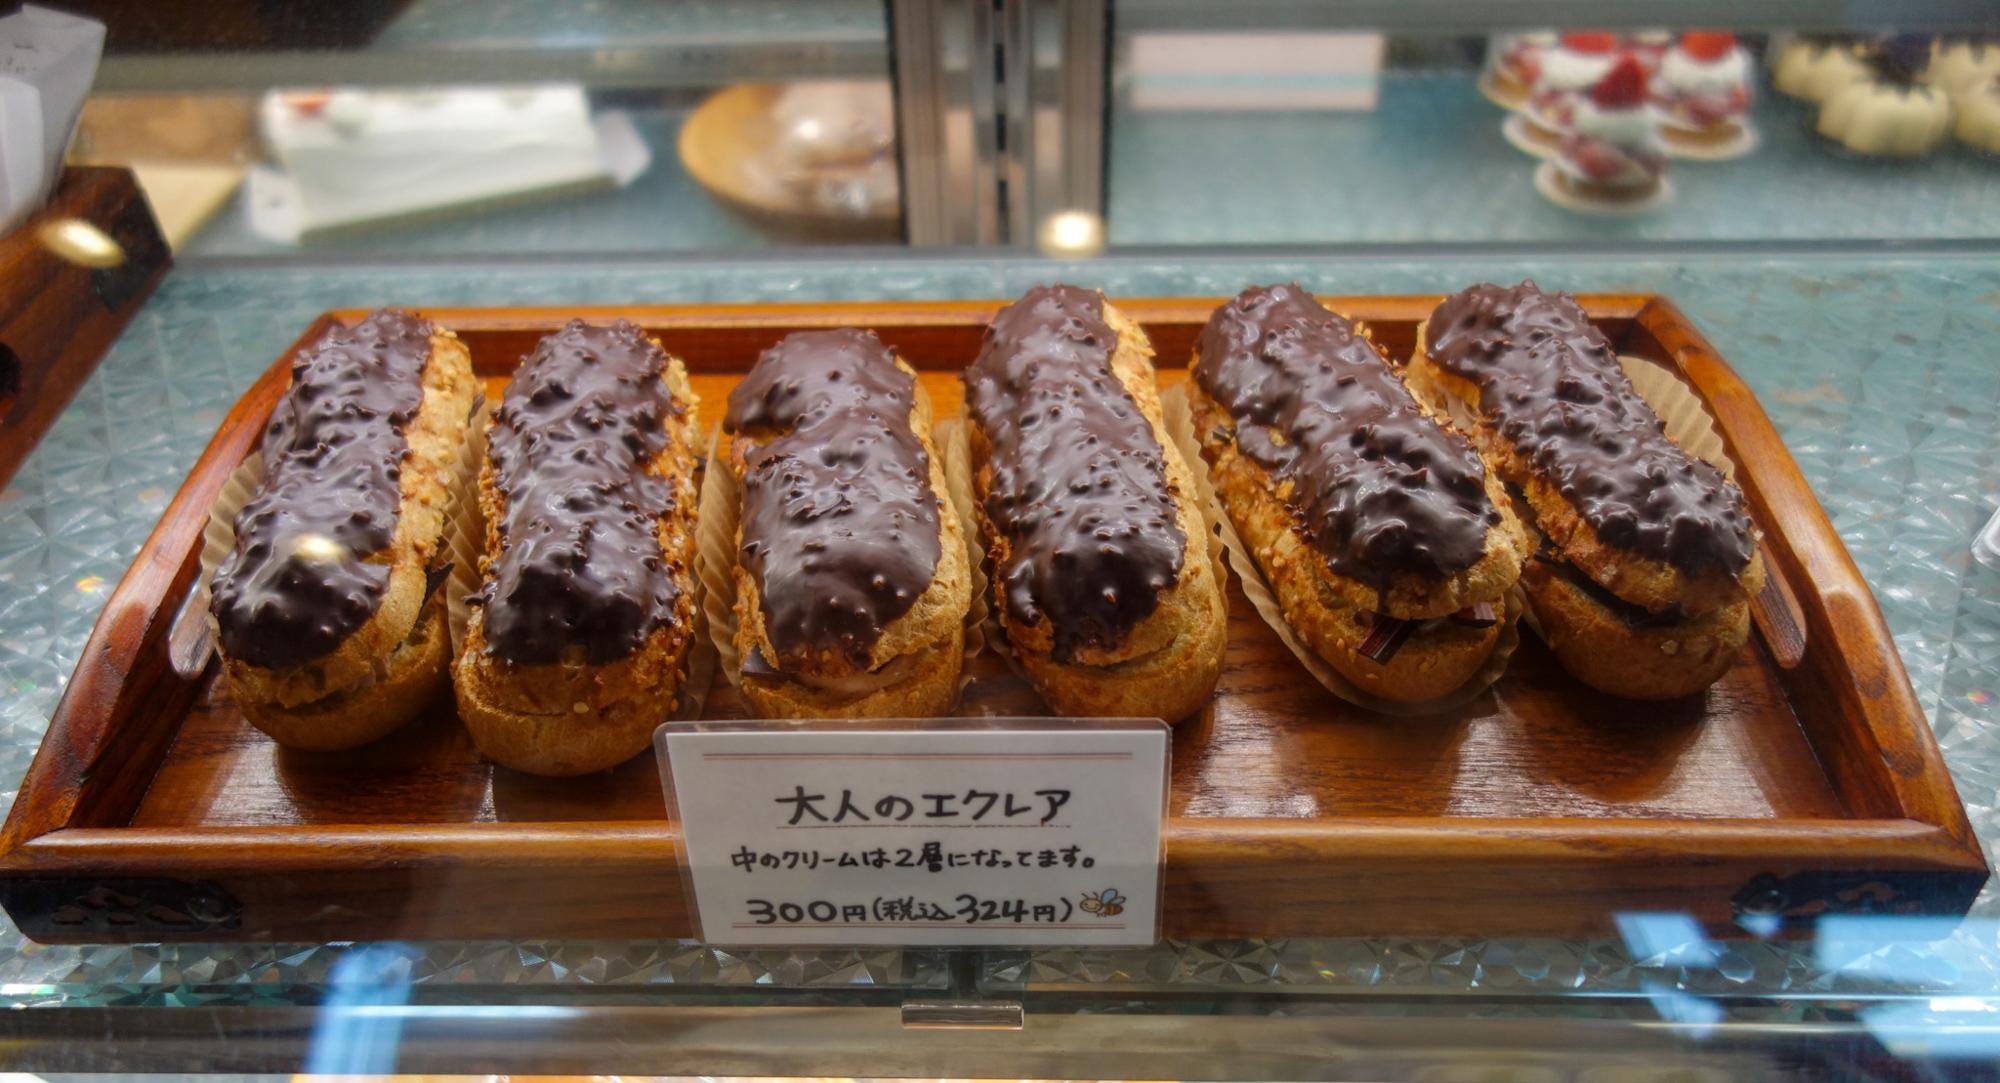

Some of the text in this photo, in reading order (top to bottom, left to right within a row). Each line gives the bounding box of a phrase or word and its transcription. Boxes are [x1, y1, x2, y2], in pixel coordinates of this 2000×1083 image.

[774, 785, 1072, 825] 大人のエクレア
[731, 842, 1096, 874] 中のクリームは2層になってます。
[746, 894, 1073, 924] 300円(税込324円)
